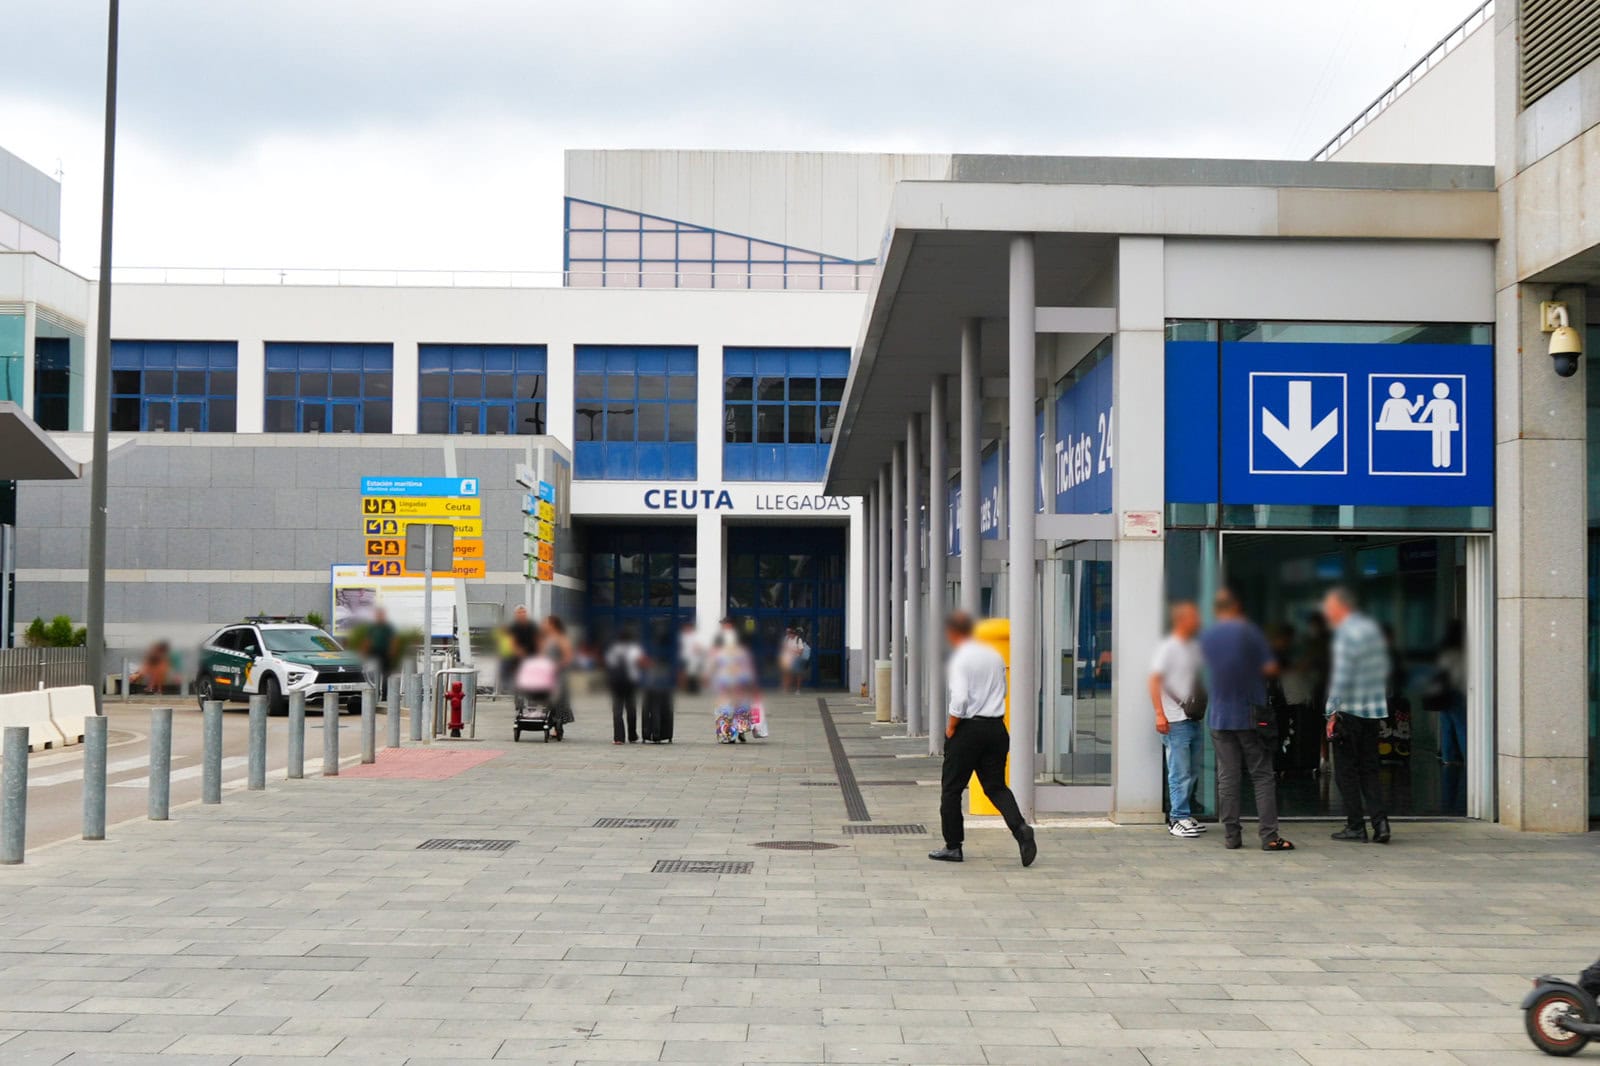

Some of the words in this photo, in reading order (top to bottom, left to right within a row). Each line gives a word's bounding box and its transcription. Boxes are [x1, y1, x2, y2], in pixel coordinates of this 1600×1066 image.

[1056, 432, 1092, 495] Tickets
[644, 489, 734, 510] CEUTA
[756, 494, 850, 510] LLEGADAS
[445, 503, 471, 511] Ceuta
[452, 567, 478, 575] anger
